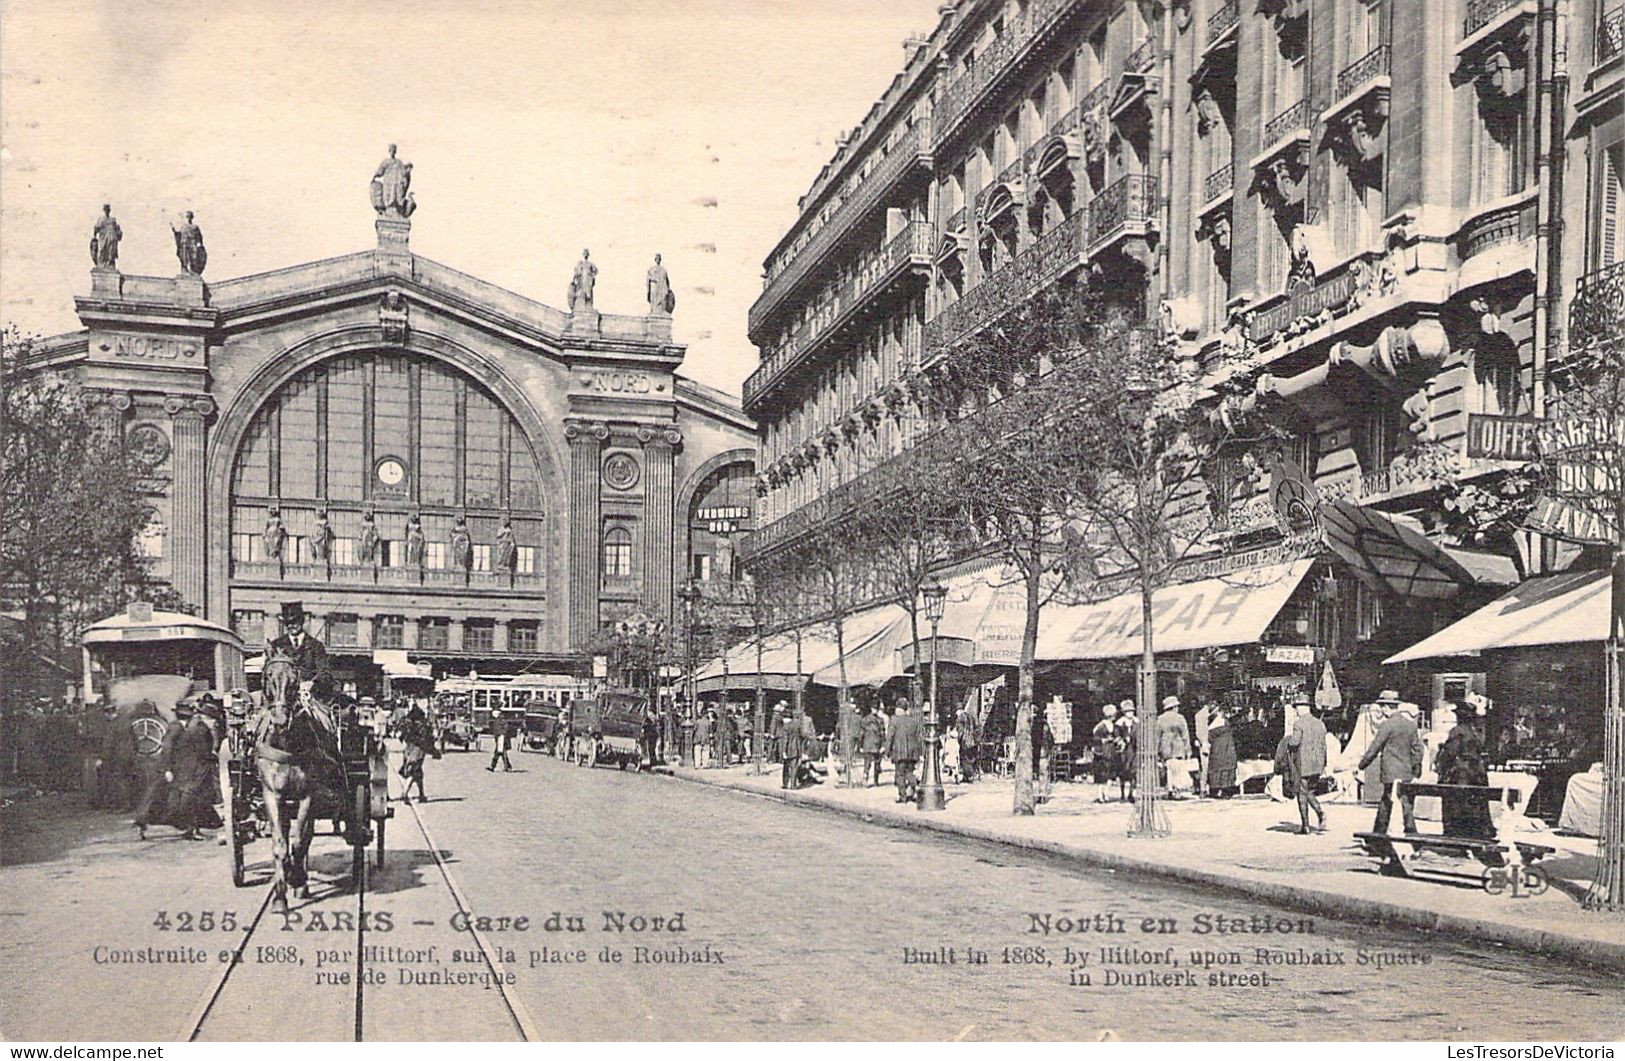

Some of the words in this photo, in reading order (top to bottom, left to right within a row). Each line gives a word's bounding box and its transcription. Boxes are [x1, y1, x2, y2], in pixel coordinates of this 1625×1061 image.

[114, 336, 178, 359] NORD
[593, 372, 650, 393] NORD
[1065, 587, 1250, 643] BAZAR
